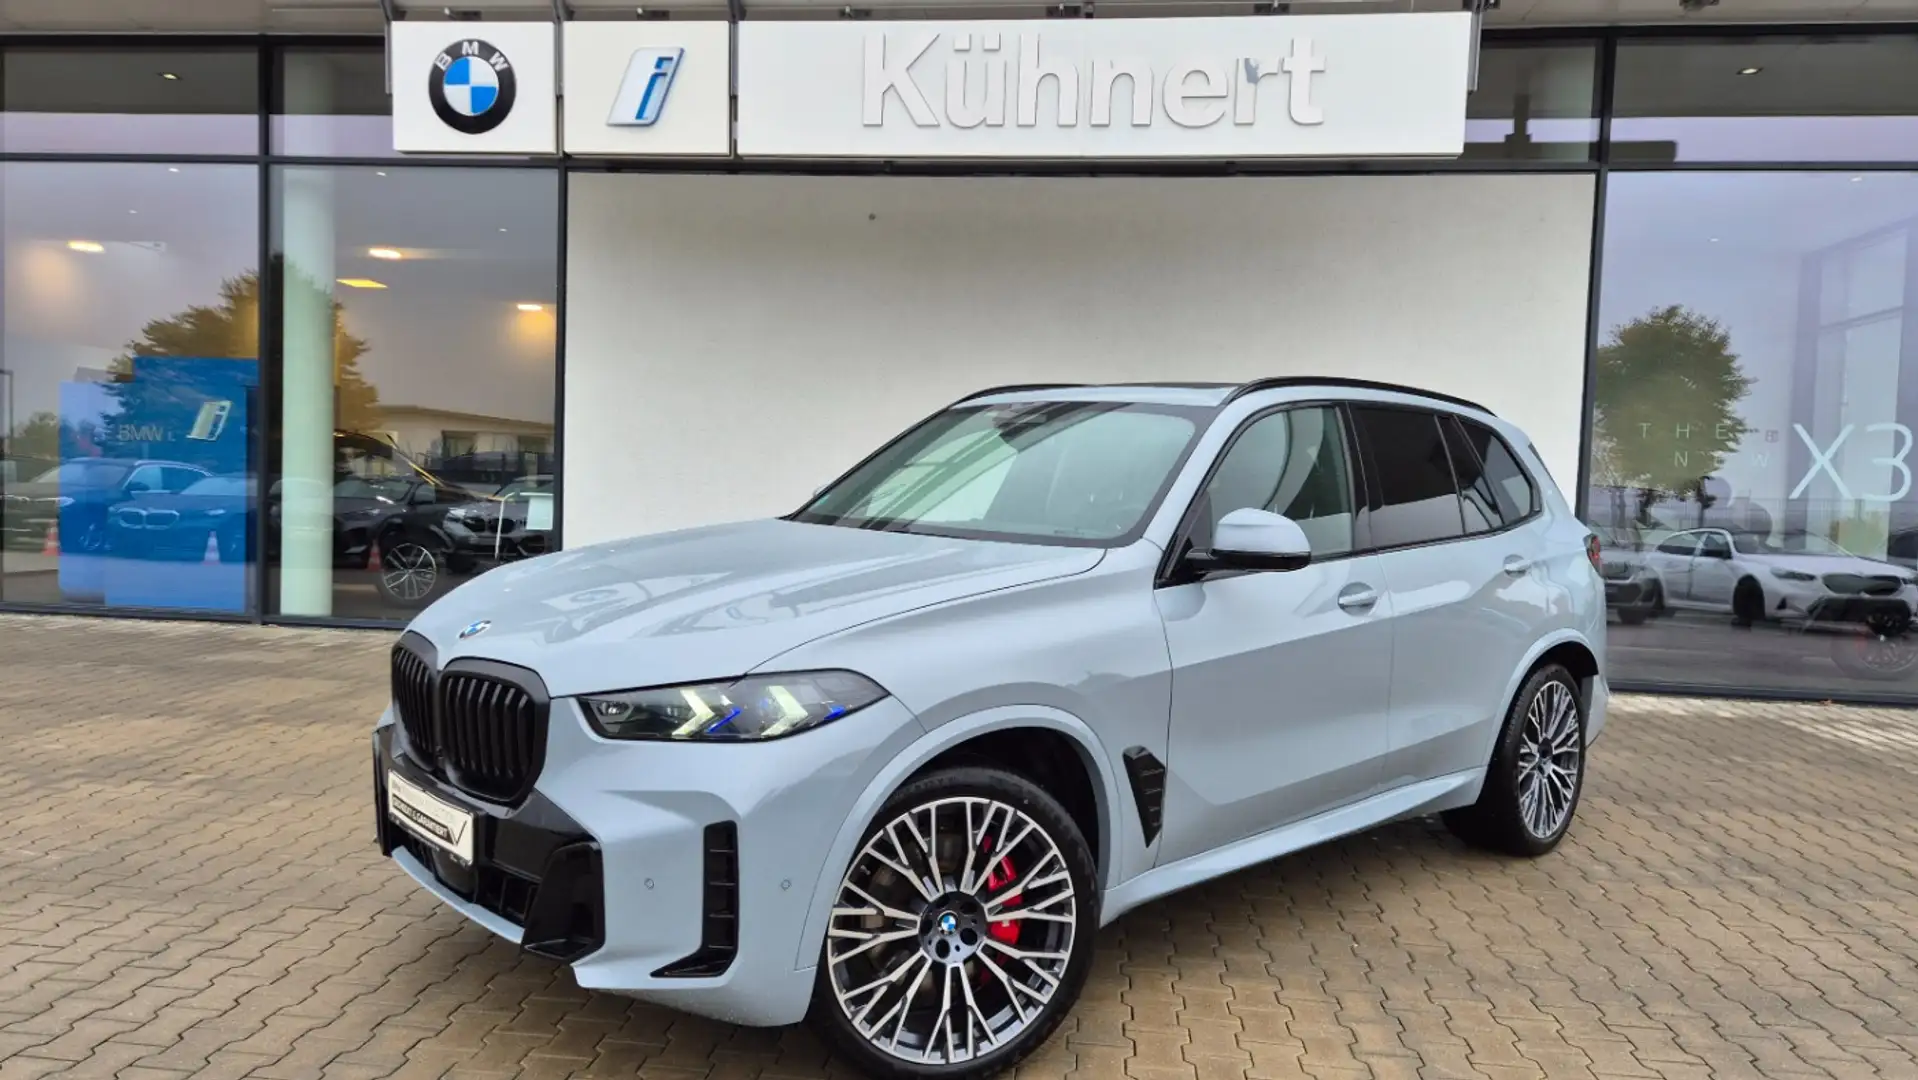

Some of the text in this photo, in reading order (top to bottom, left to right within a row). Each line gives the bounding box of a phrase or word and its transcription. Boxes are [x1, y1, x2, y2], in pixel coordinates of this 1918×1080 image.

[435, 41, 509, 71] BMW
[861, 33, 1326, 128] Kühnert
[1639, 422, 1729, 439] THE
[1789, 422, 1913, 501] X3
